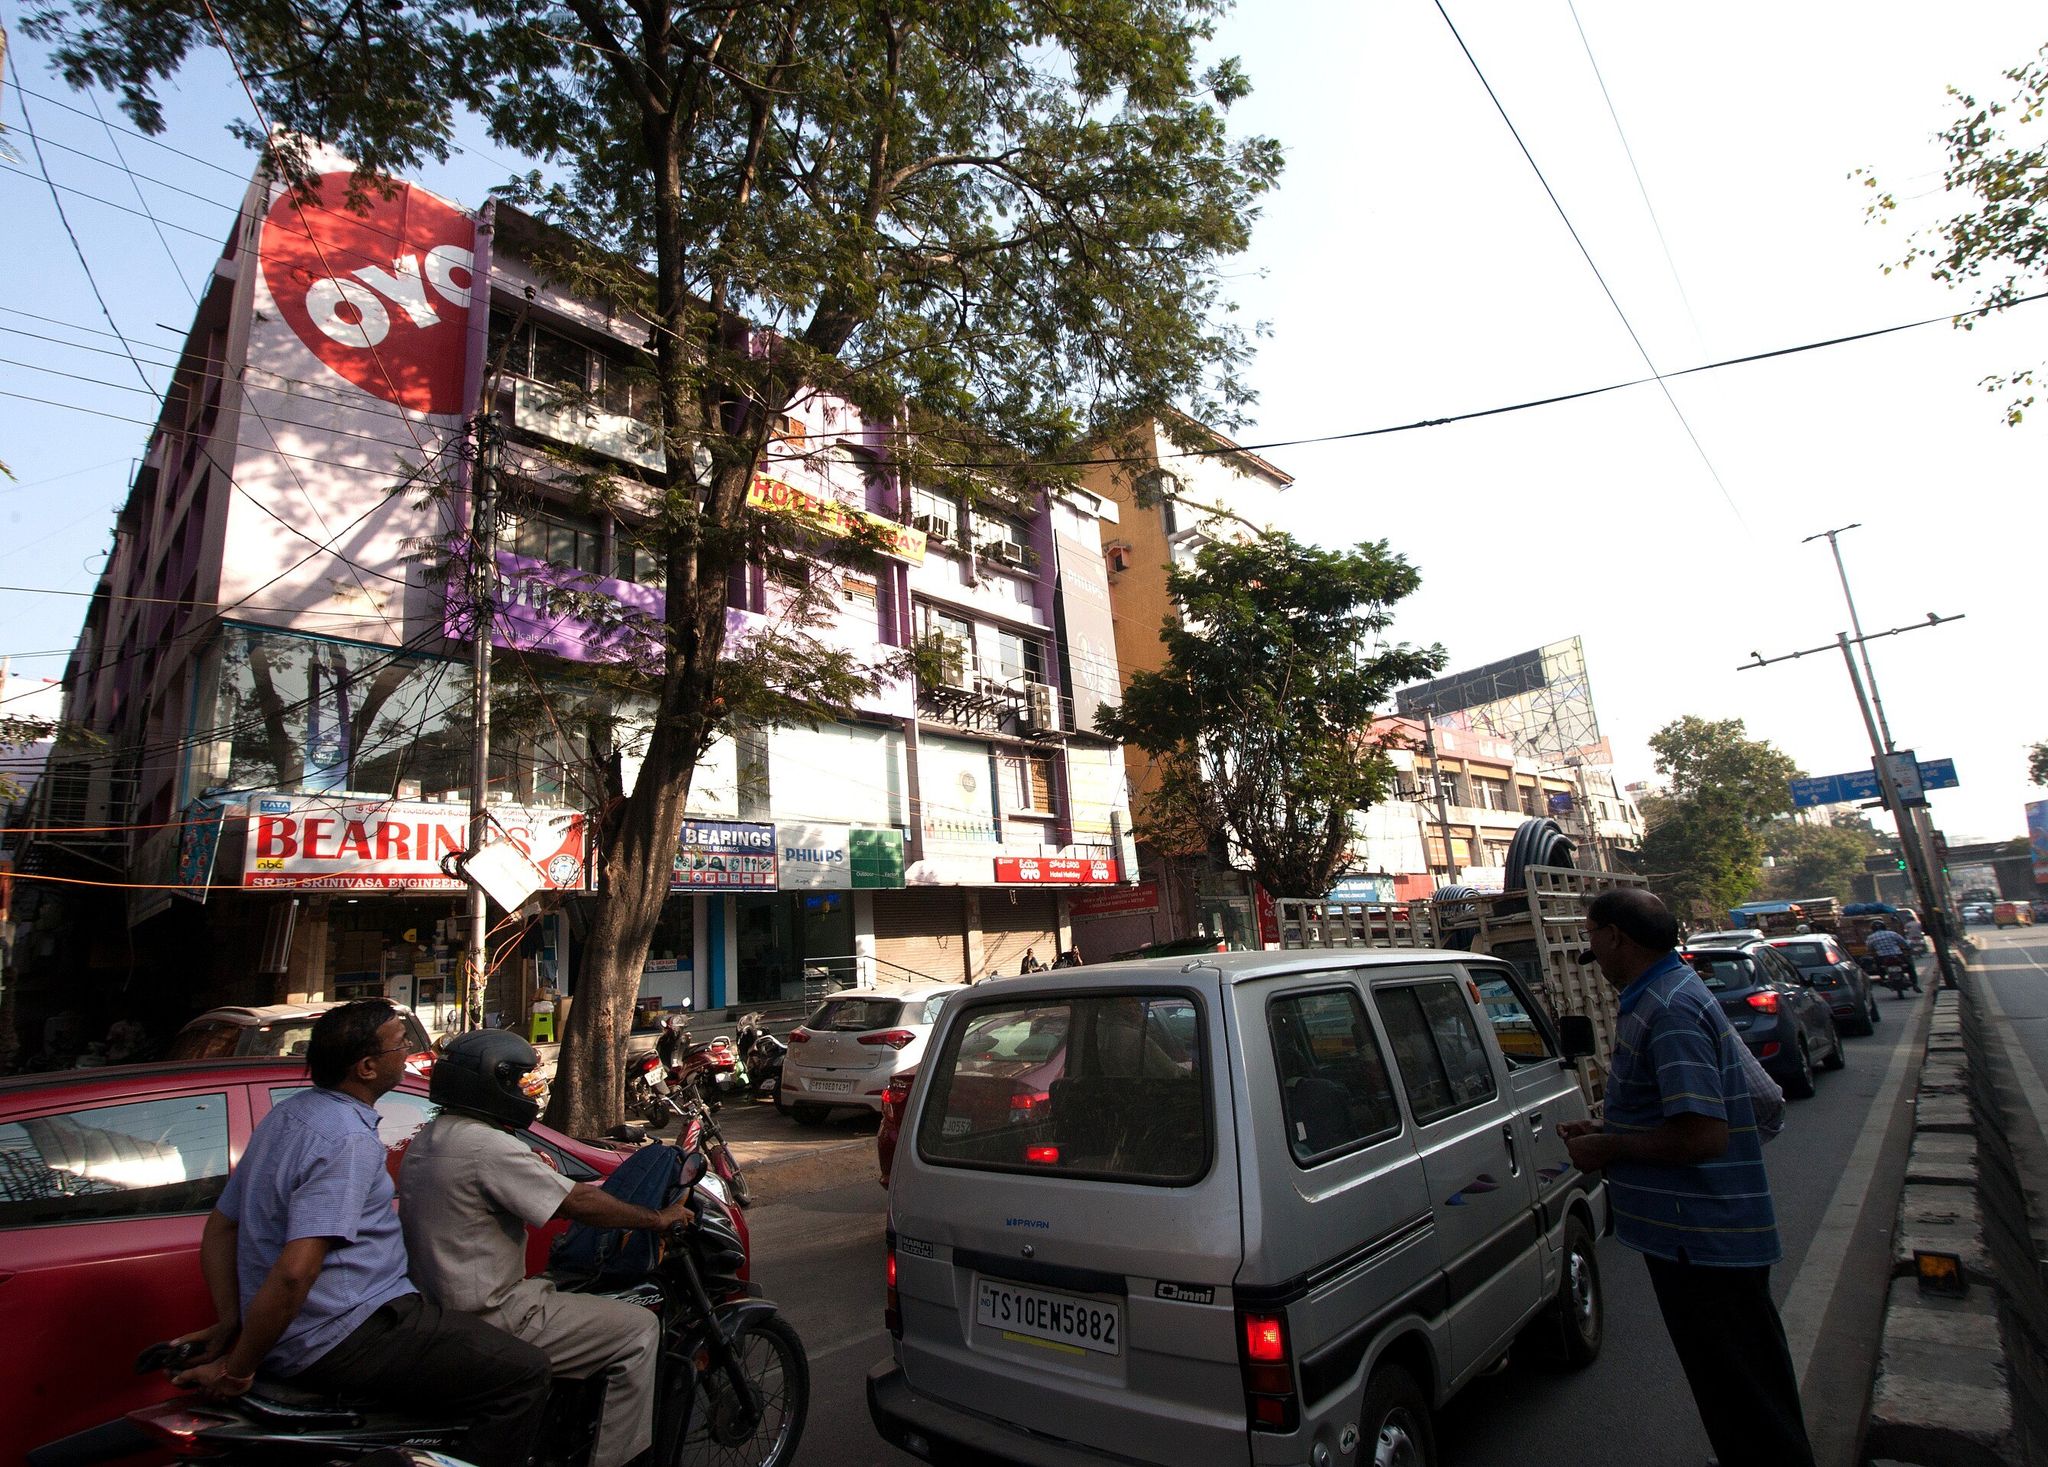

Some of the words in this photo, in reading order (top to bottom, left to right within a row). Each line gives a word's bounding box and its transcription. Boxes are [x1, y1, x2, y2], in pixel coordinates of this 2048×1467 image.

[305, 244, 475, 348] OYO
[257, 816, 533, 862] BEARINS
[685, 828, 772, 847] BEARINGS
[257, 859, 283, 869] nbc
[785, 847, 843, 865] PHILIPS
[252, 877, 297, 889] SREE
[301, 877, 382, 889] SRINIVASA
[1020, 869, 1041, 880] OYO
[1091, 869, 1109, 880] OYO
[1158, 1282, 1213, 1304] Omni
[989, 1289, 1116, 1345] TS10EN5882
